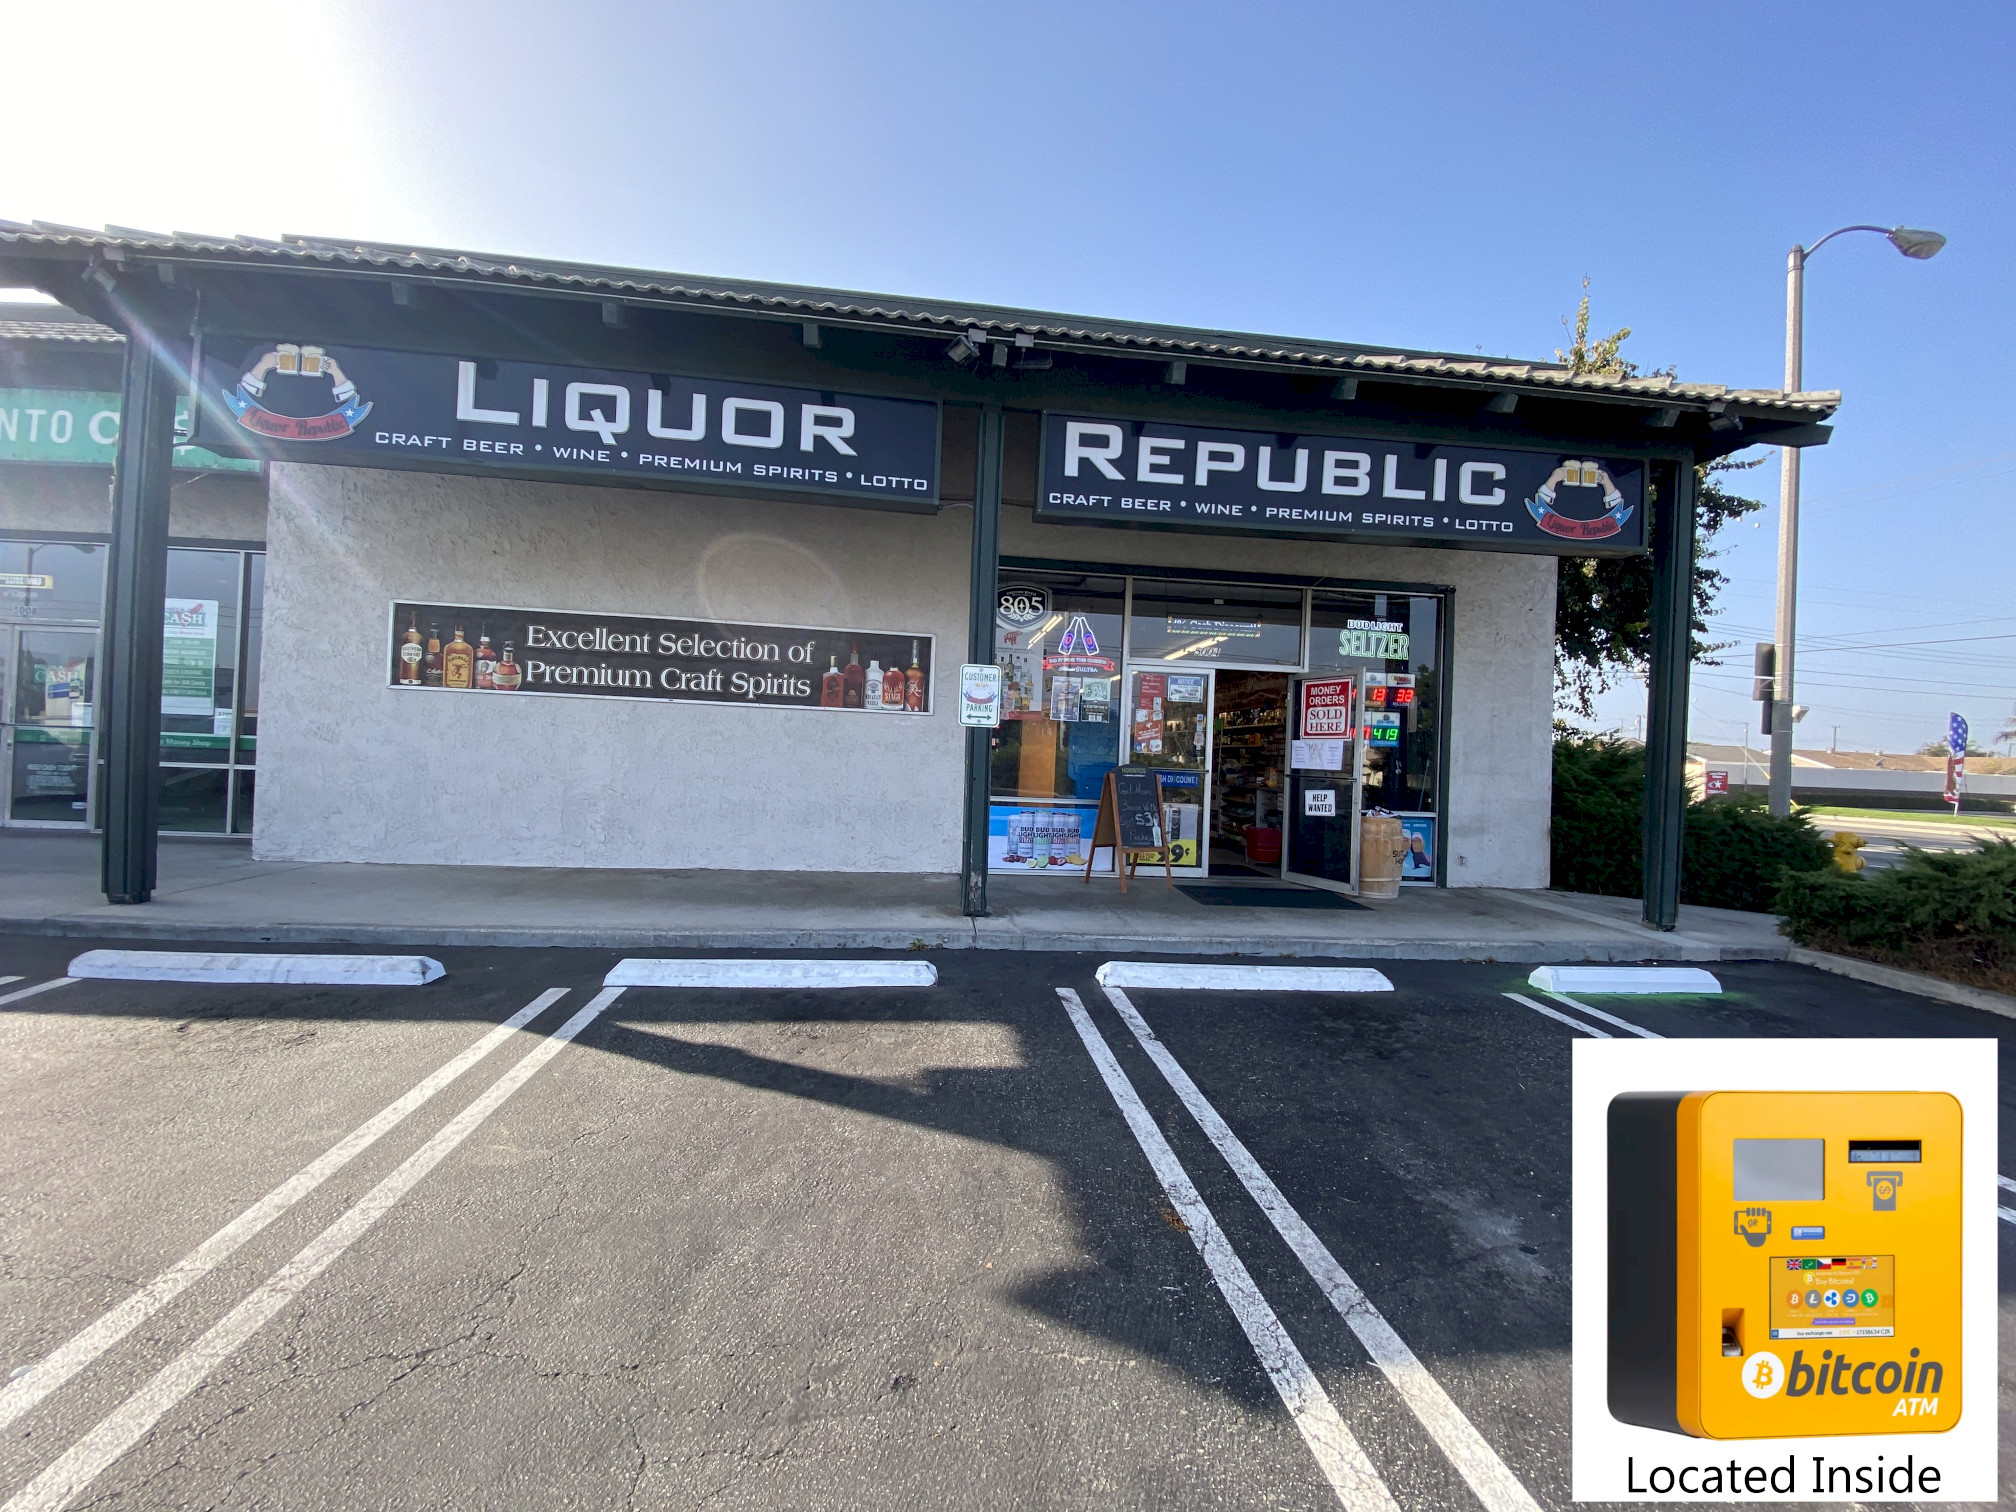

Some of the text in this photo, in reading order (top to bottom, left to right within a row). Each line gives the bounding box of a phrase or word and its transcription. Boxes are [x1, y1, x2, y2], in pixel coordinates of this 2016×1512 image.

[457, 360, 858, 457] LIQUOR
[375, 431, 928, 491] CRAFT BEER WINE PREMIUM SPIRITS LOTTO
[1064, 421, 1506, 506] REPUBLIC
[1048, 492, 1513, 532] CRAFT BEER WINE PREMIUM SPIRITS LOTTO
[1000, 595, 1044, 616] 805
[1347, 619, 1403, 632] BUD LIGHT
[526, 624, 816, 663] Excellent Selection of
[1339, 629, 1410, 660] SELTZER
[526, 660, 812, 699] Premium Craft Spirits
[964, 672, 997, 682] CUSTOMER
[1310, 685, 1341, 695] MONEY
[1373, 688, 1387, 702] 13
[1396, 688, 1416, 703] 32
[1309, 695, 1345, 705] ORDERS
[966, 703, 993, 713] PARKING
[1309, 708, 1342, 720] SOLD
[1309, 721, 1342, 732] HERE
[192, 738, 211, 747] Shop
[1312, 794, 1328, 802] HELP
[1308, 804, 1333, 813] WANTED
